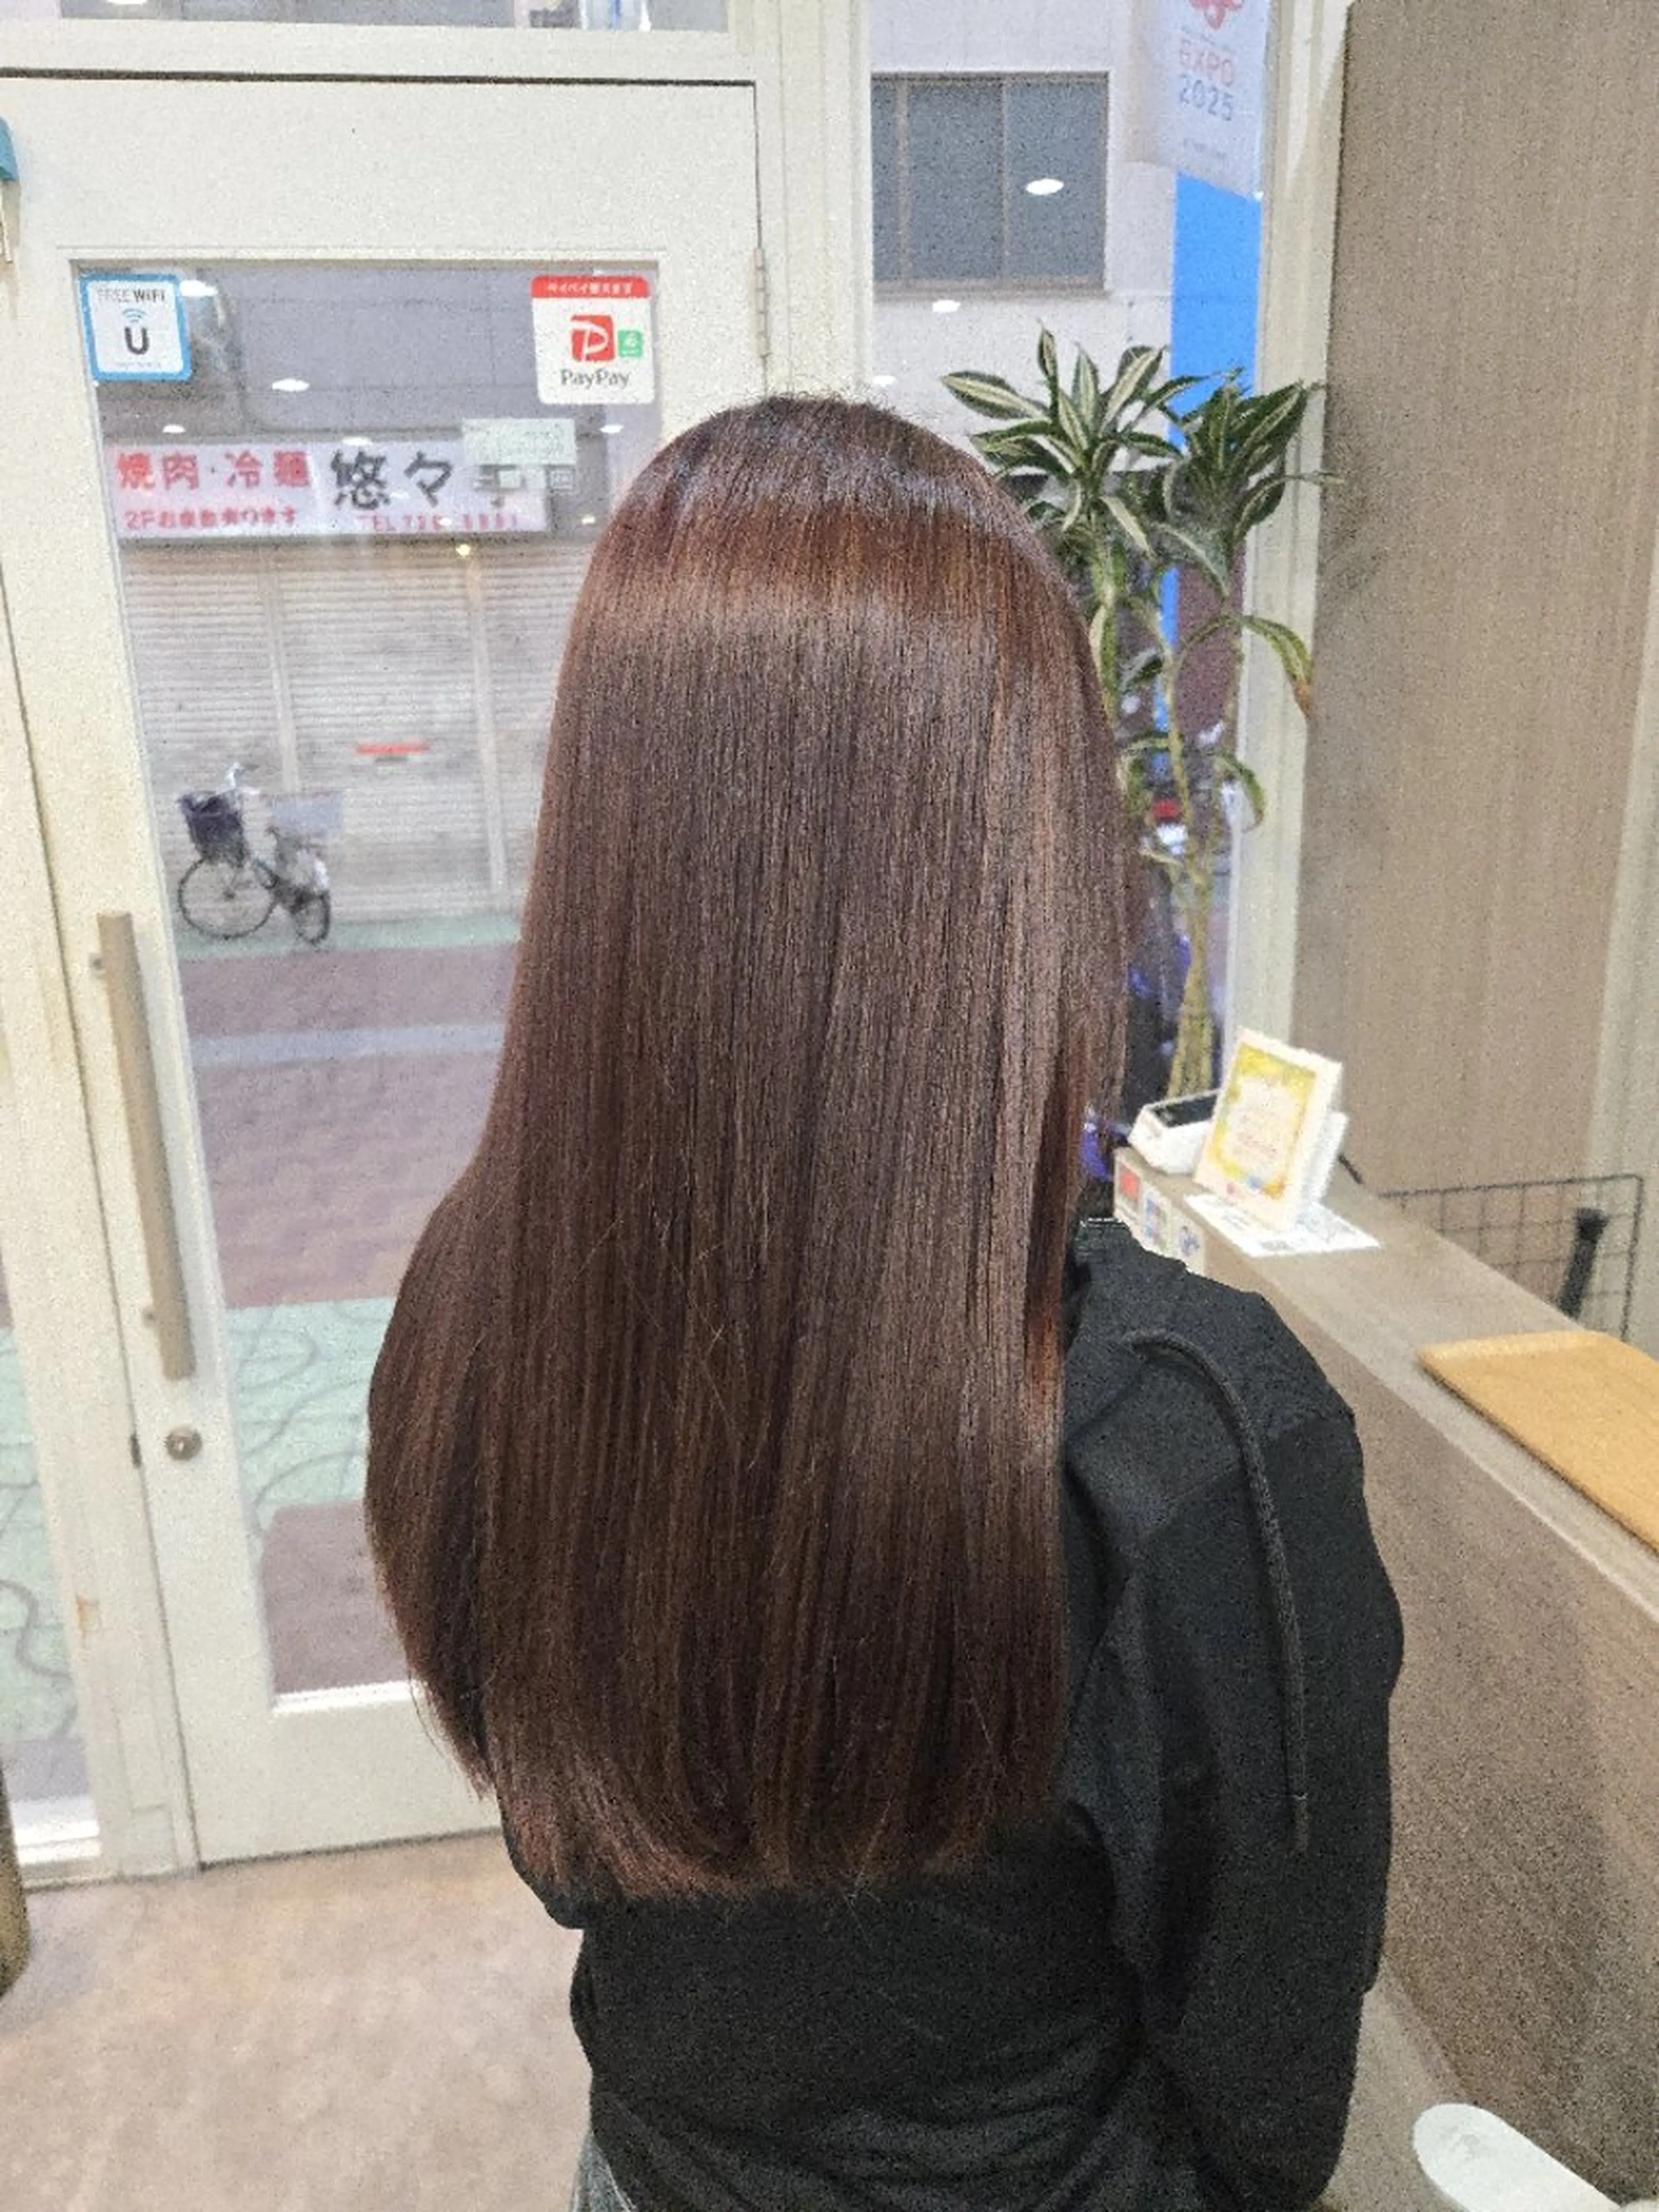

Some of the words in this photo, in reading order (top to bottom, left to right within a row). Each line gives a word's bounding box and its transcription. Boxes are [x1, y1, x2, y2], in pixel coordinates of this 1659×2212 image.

[1179, 38, 1234, 87] EXPO
[1179, 73, 1233, 121] 2025
[124, 326, 149, 355] U
[561, 369, 631, 389] PayPay
[331, 451, 452, 510] 悠々
